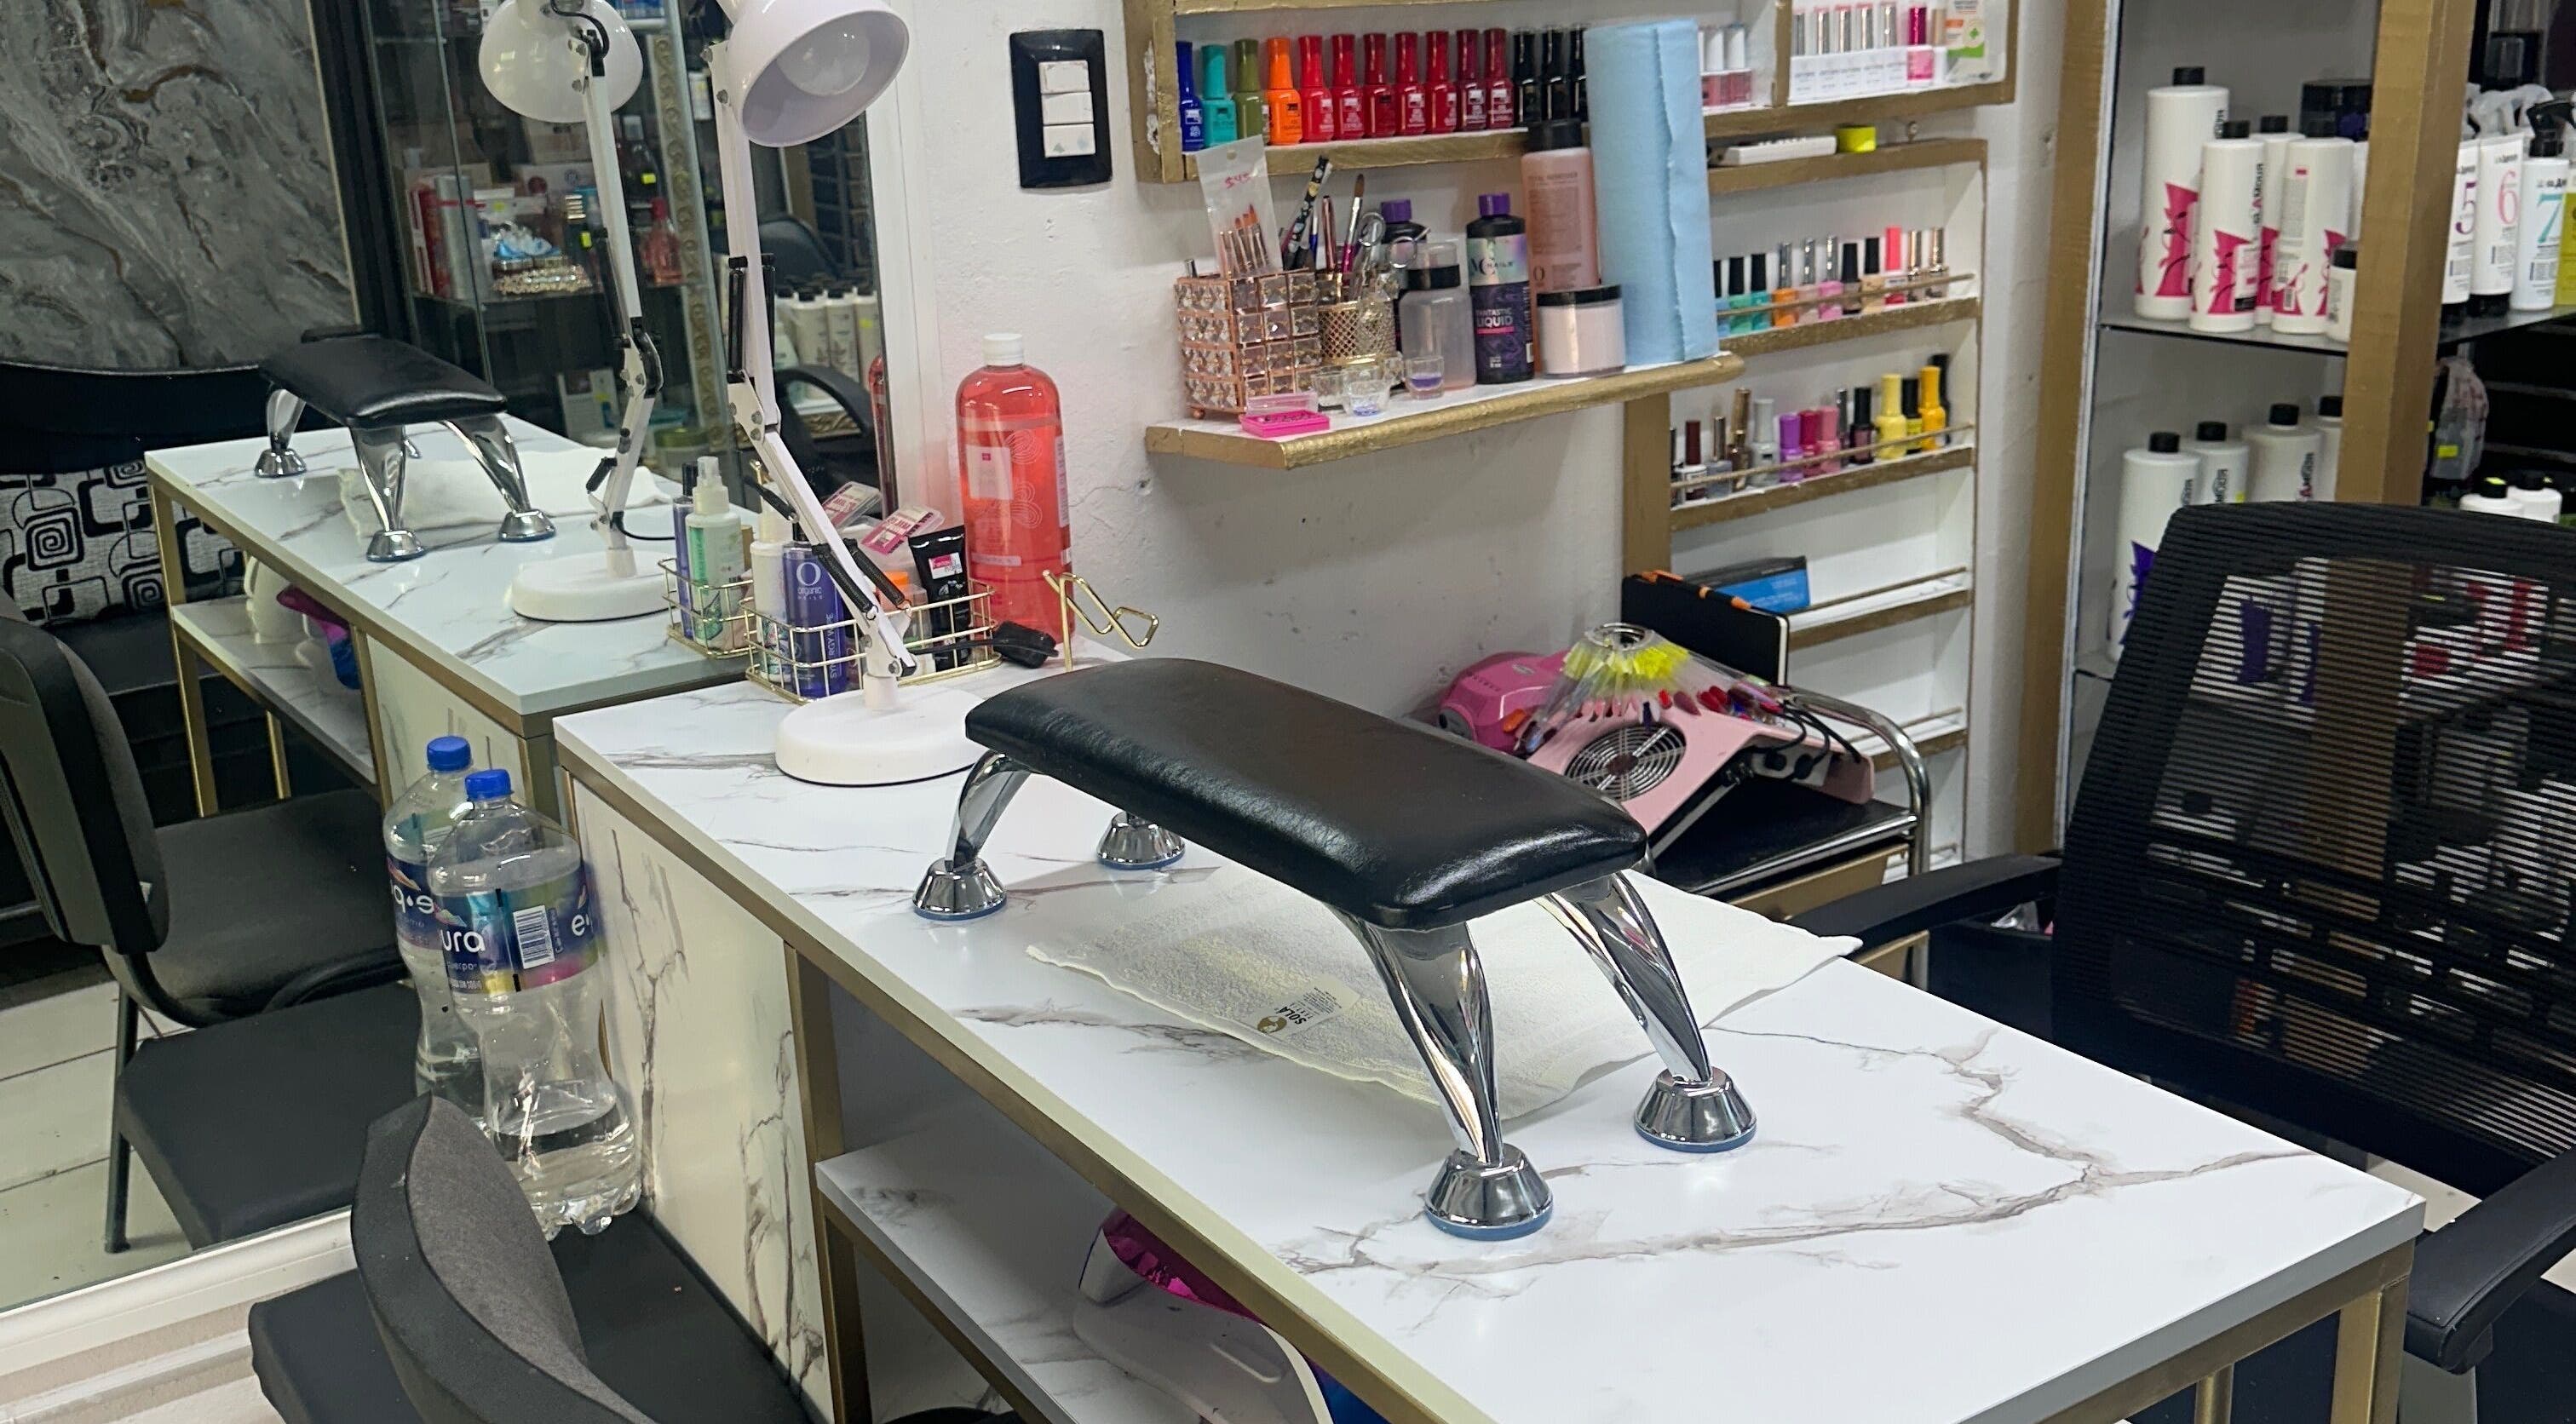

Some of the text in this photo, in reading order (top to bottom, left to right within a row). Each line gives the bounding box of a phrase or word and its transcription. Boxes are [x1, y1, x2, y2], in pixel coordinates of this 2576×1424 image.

[2454, 181, 2477, 235] 5
[2498, 169, 2518, 225] 6
[2536, 192, 2563, 244] 7
[1477, 315, 1514, 329] LIQUID
[827, 640, 837, 678] SYNRGY
